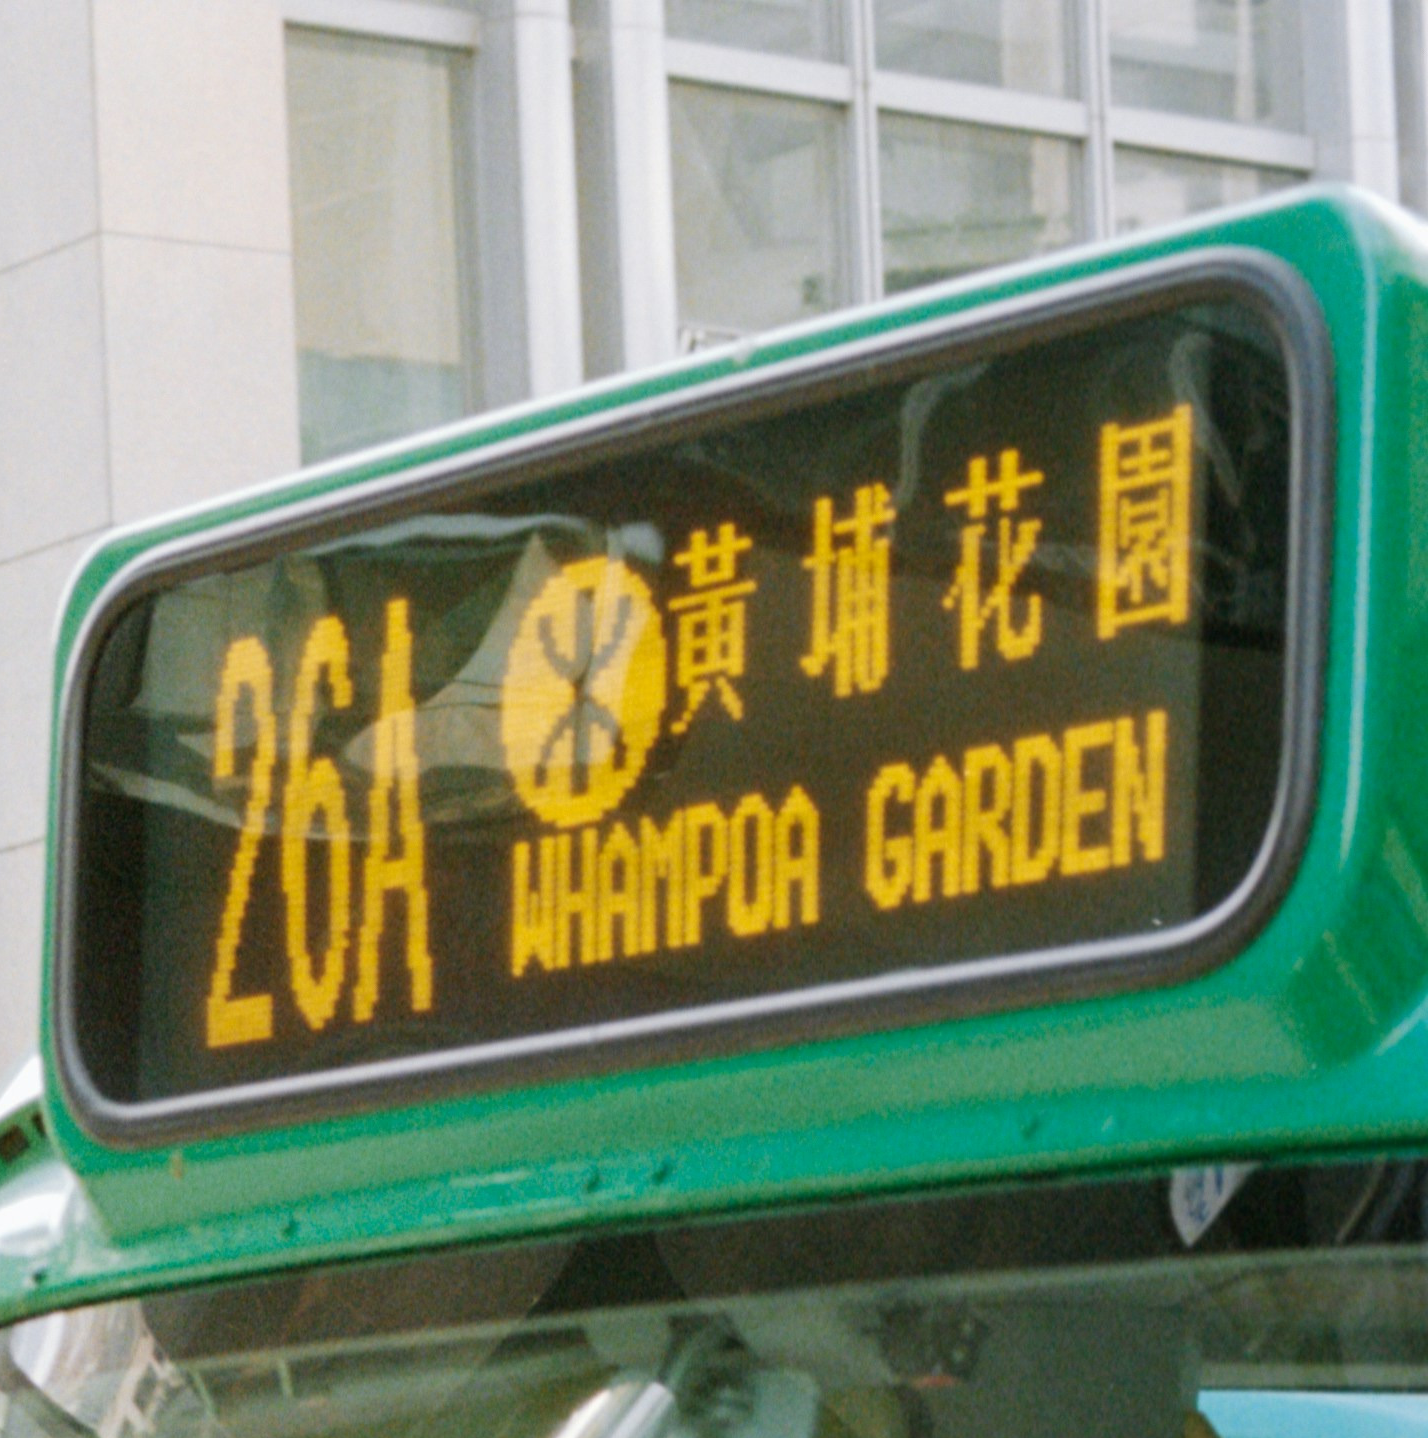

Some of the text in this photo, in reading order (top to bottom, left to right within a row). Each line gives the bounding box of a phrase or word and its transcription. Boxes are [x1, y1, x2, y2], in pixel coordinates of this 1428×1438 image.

[669, 404, 1192, 737] 黃埔花園
[207, 599, 433, 1048] 26A
[512, 710, 1167, 977] WHAMPOA GARDEN
